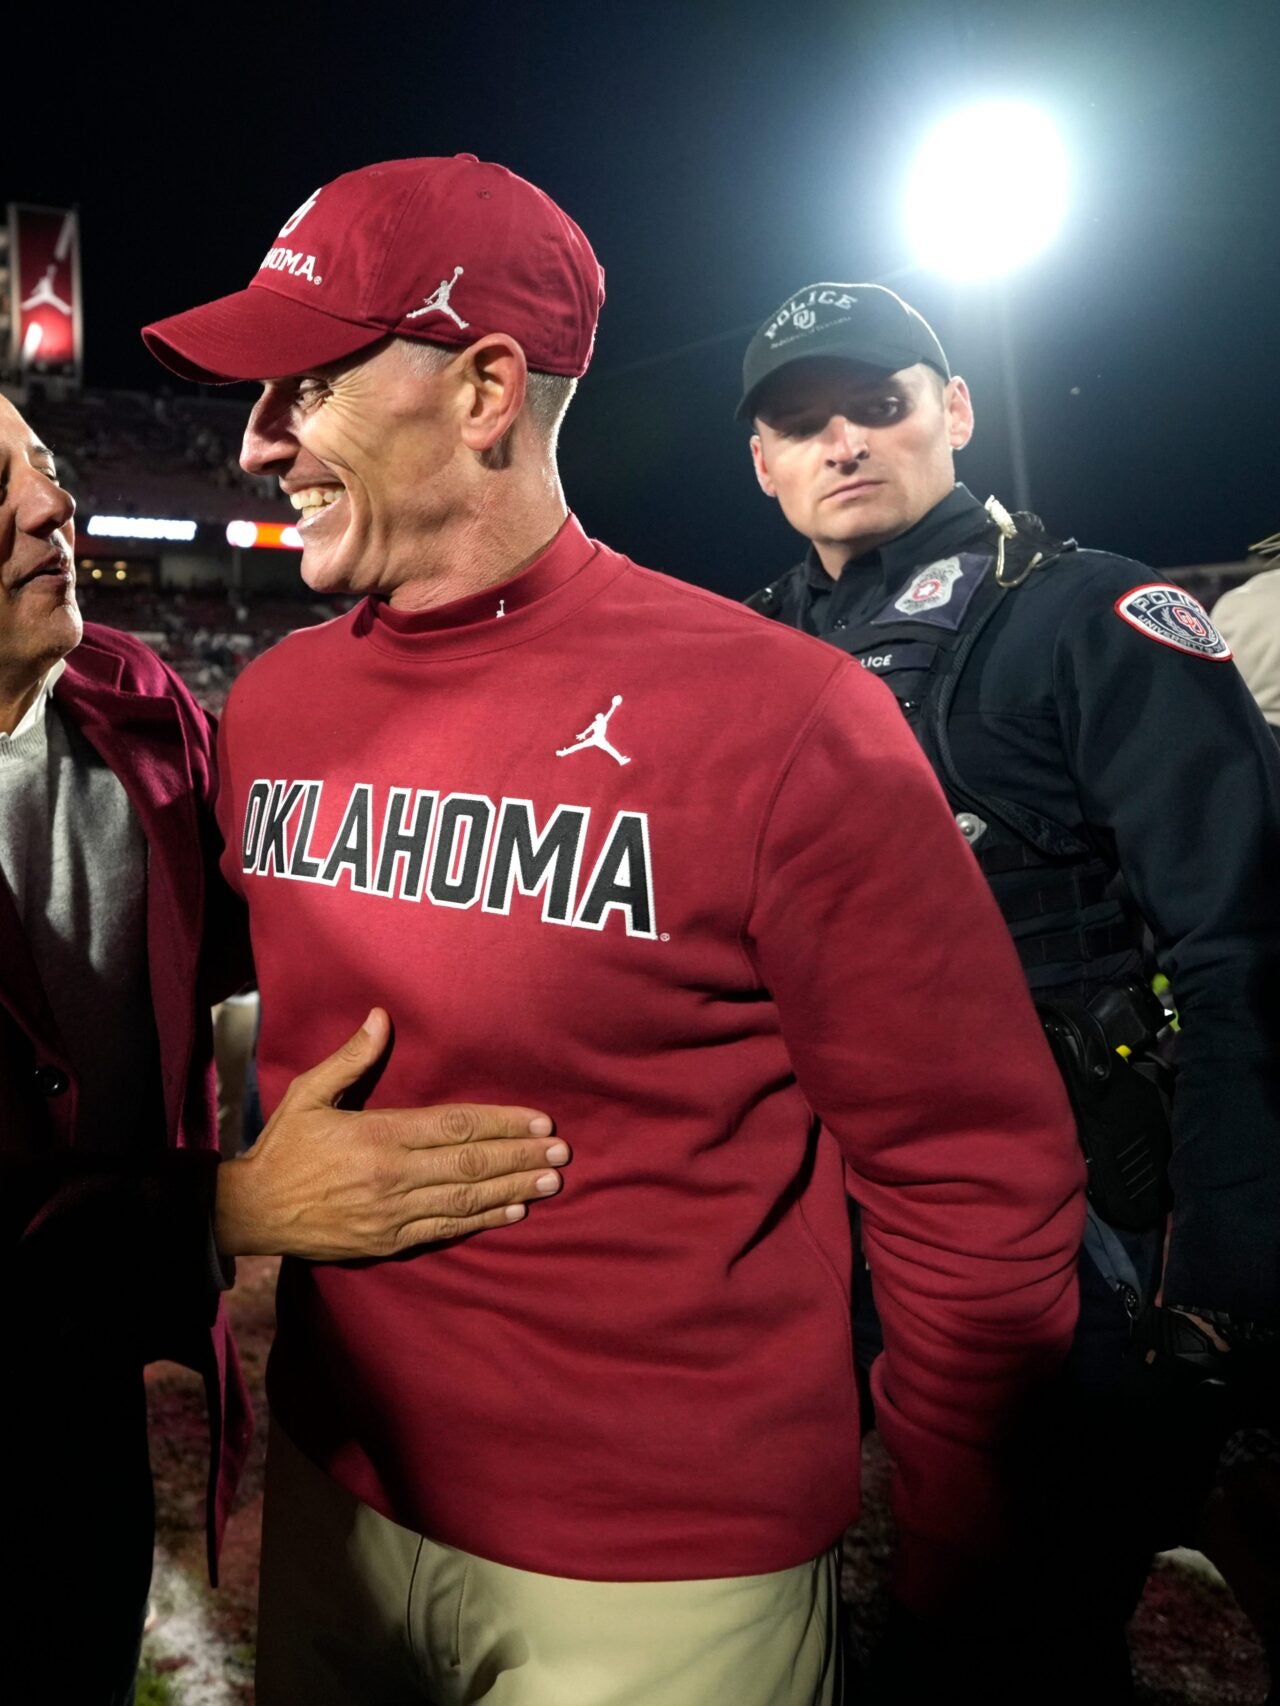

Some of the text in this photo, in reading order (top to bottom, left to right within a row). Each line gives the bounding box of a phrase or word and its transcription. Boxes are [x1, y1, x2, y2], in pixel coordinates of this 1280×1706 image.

[764, 290, 858, 341] POLICE
[793, 309, 817, 330] OU
[1131, 590, 1202, 613] POLIC
[860, 653, 893, 669] LICE
[242, 779, 658, 940] OKLAHOMA
